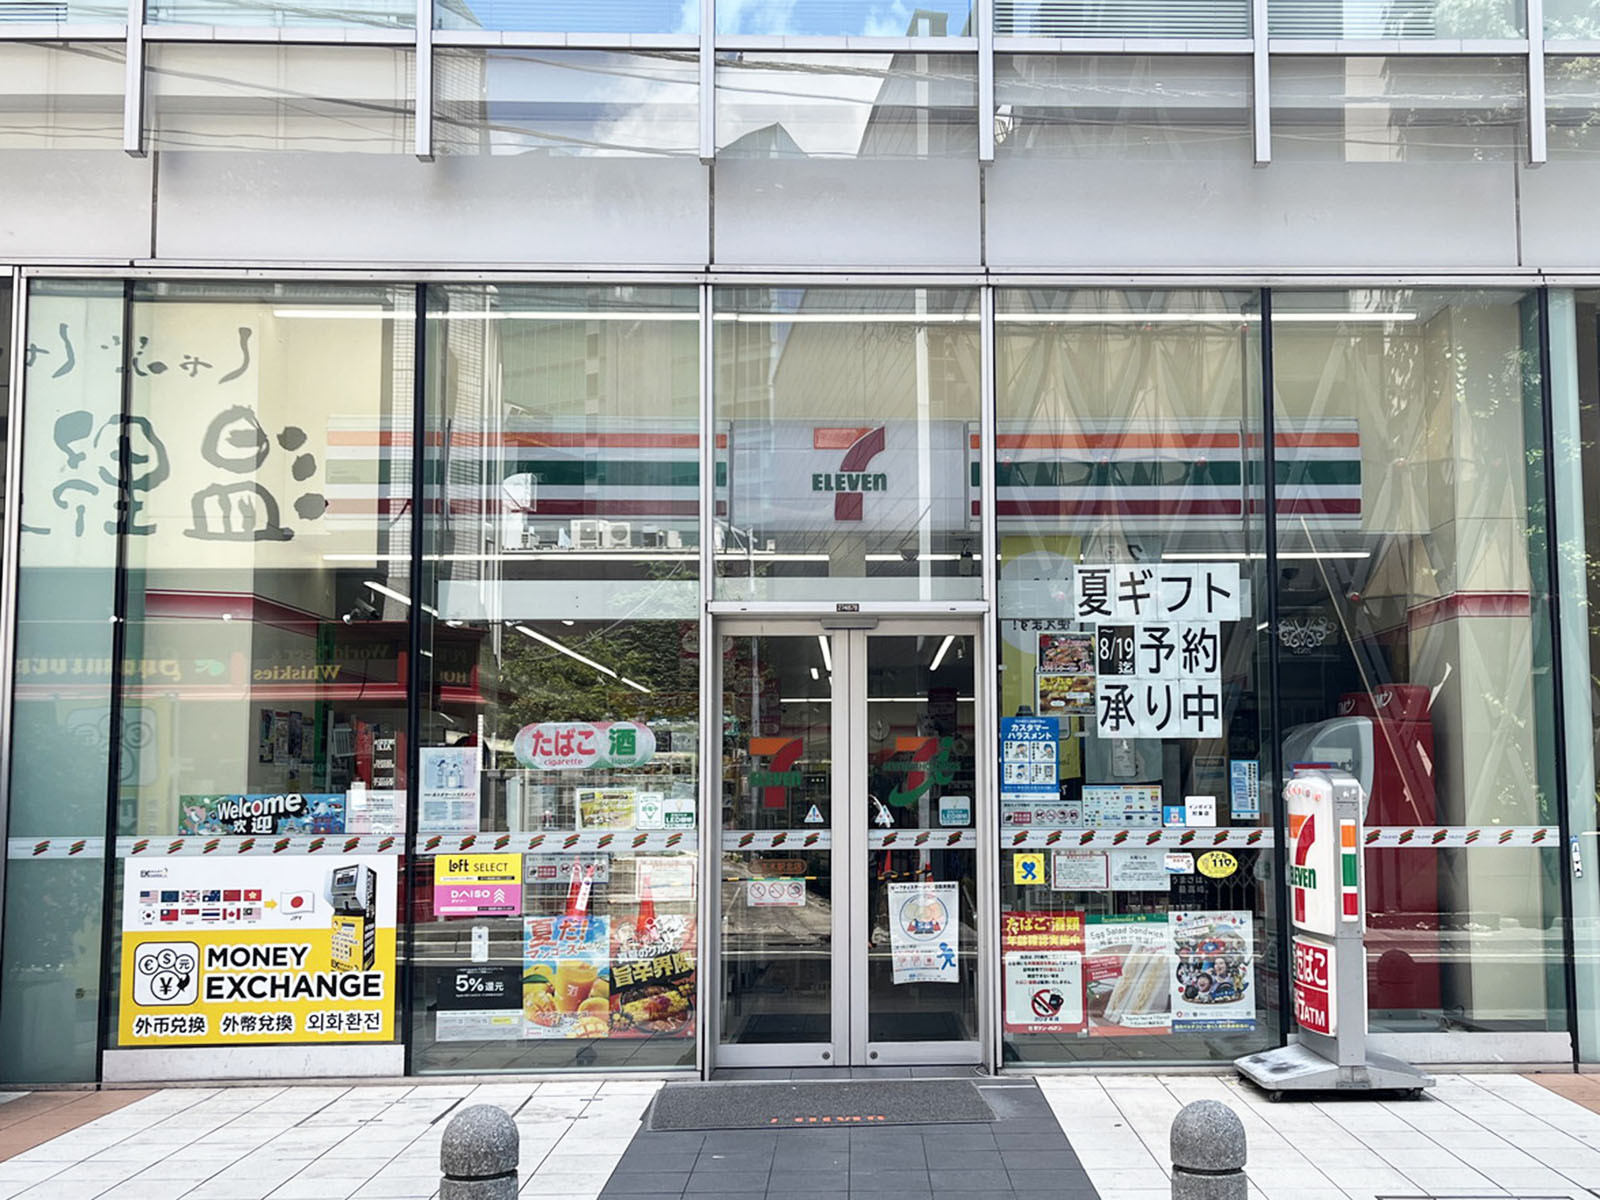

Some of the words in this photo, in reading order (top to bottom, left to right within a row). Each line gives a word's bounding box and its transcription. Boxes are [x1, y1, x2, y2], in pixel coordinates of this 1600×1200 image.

[1077, 568, 1231, 617] 夏ギフト
[1100, 637, 1134, 660] 8/19
[1140, 627, 1218, 674] 予約
[1099, 684, 1219, 732] 承り中
[1007, 732, 1052, 740] ハラスメント
[1011, 724, 1049, 732] カスタマー
[532, 728, 596, 757] たばこ
[608, 728, 636, 756] 酒
[217, 793, 302, 822] Welcome
[233, 816, 274, 835] 欢迎
[449, 859, 469, 872] Loft
[474, 862, 509, 872] SELECT
[451, 889, 491, 899] DAISO
[207, 946, 308, 967] MONEY
[206, 974, 382, 1000] EXCHANGE
[135, 1016, 206, 1035] 外币兑换
[308, 1012, 380, 1031] 외화환전
